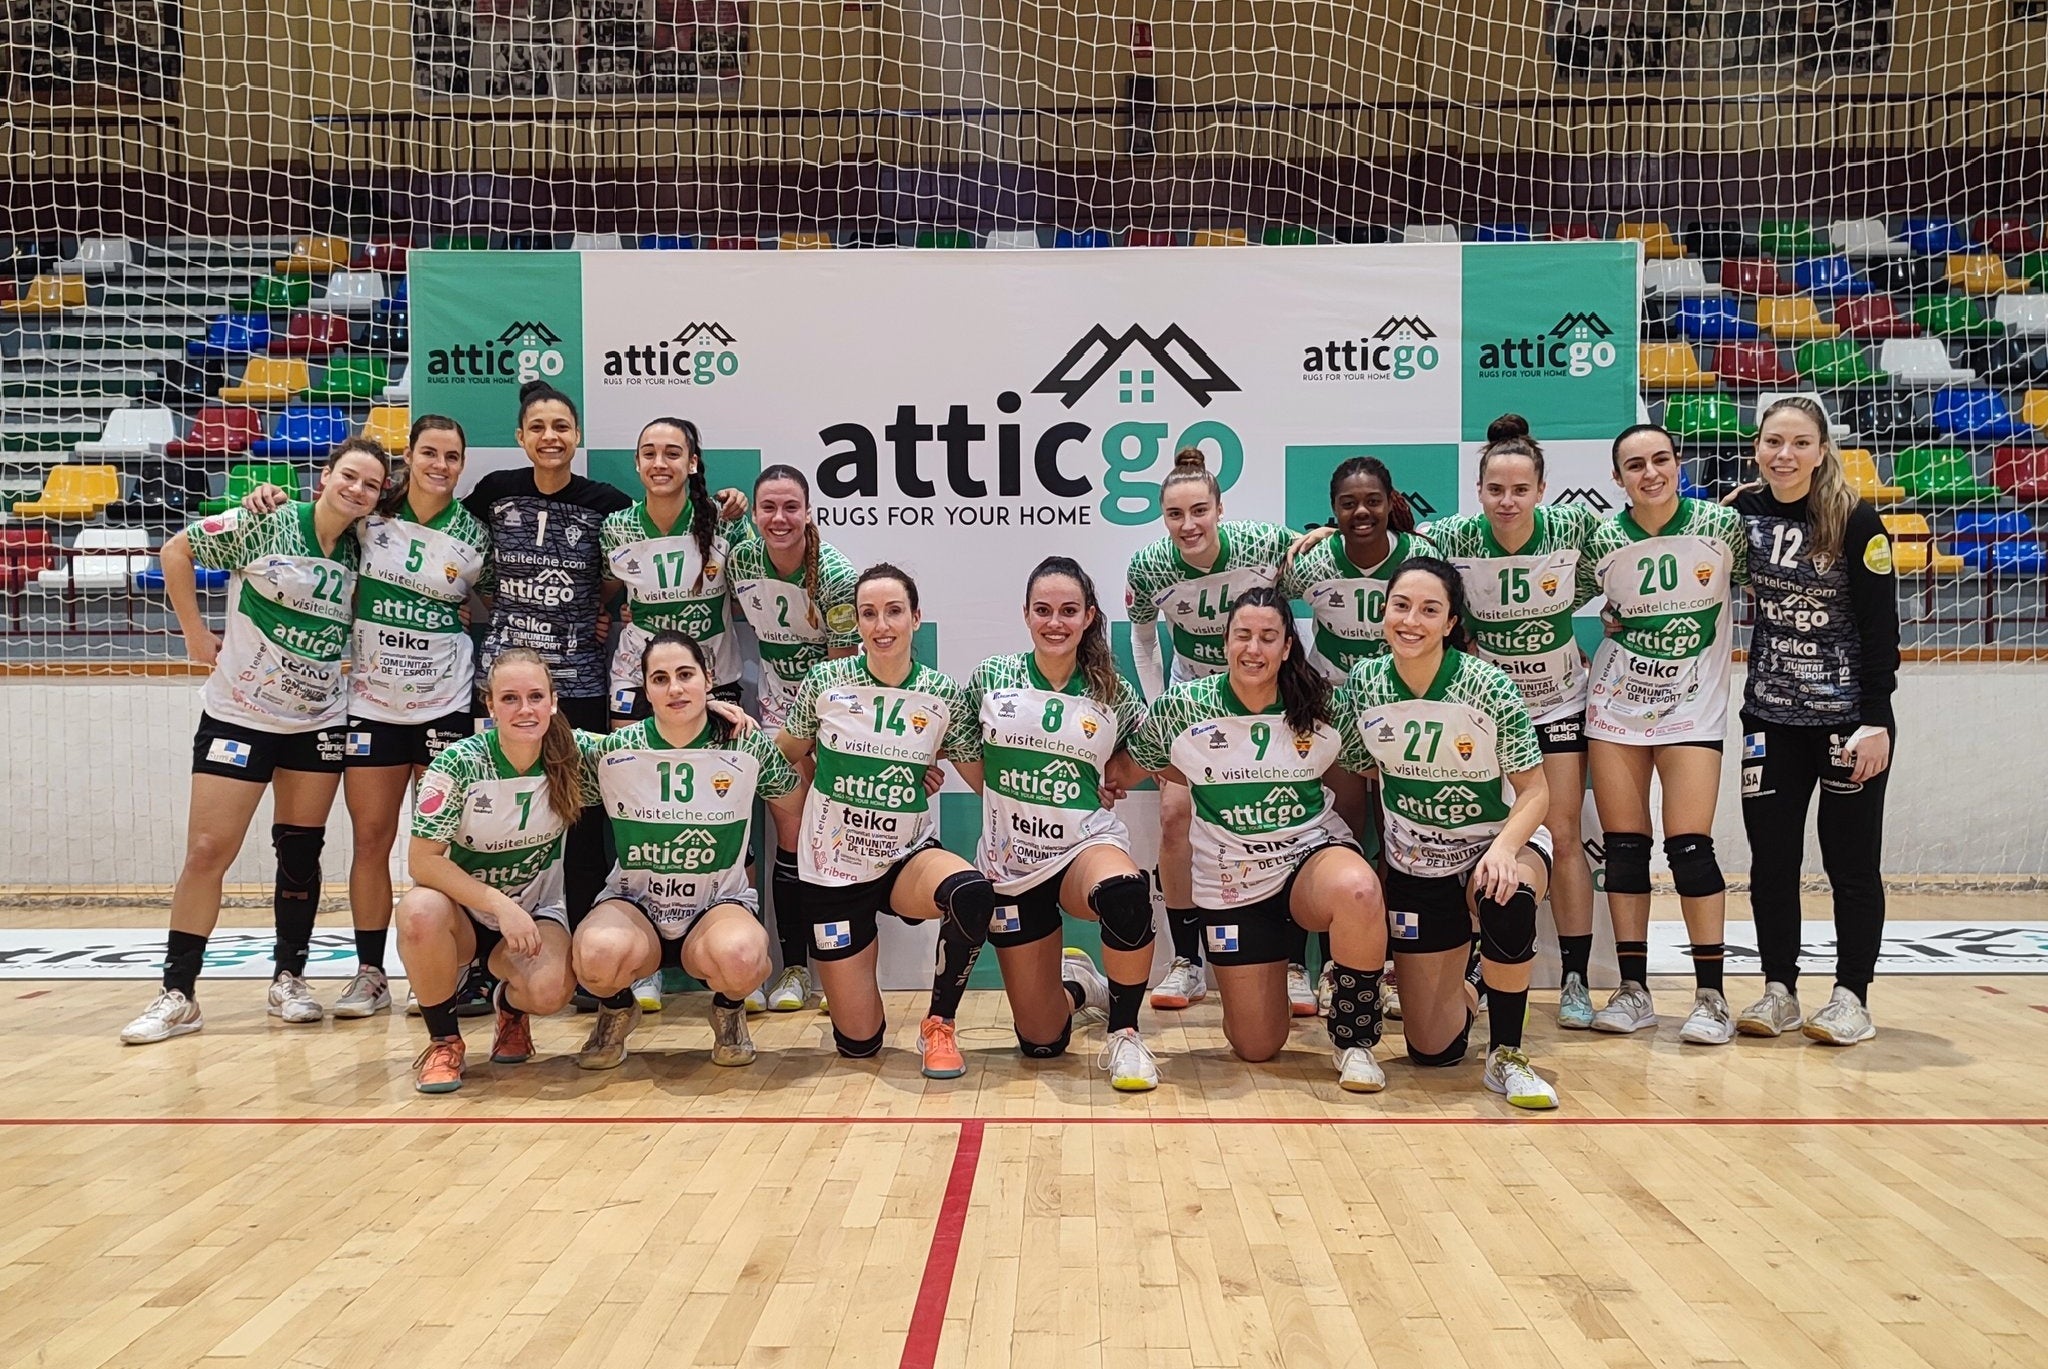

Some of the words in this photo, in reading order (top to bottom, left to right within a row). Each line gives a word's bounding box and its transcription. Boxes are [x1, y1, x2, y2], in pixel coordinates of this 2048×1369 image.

[427, 341, 564, 384] atticgo
[604, 341, 738, 385] atticgo
[1303, 338, 1438, 380] atticgo
[1480, 335, 1616, 376] atticgo
[1303, 373, 1324, 381] RUGS
[1327, 373, 1341, 381] FOR
[1344, 373, 1364, 381] YOUR
[1366, 373, 1390, 381] HOME
[1480, 370, 1501, 378] RUGS
[1504, 370, 1517, 378] FOR
[1520, 370, 1542, 378] YOUR
[1544, 370, 1567, 378] HOME
[816, 390, 1244, 526] atticgo
[536, 511, 547, 546] 1
[817, 507, 877, 526] RUGS
[888, 507, 935, 526] FOR
[945, 507, 1010, 526] YOUR
[1020, 506, 1091, 526] HOME
[405, 539, 425, 573] 5
[1770, 525, 1803, 569] 12
[502, 553, 586, 569] visitelche.com
[653, 551, 684, 588] 17
[312, 565, 342, 604] 22
[1498, 568, 1530, 605] 15
[1637, 554, 1678, 596] 20
[500, 578, 574, 605] atticgo
[373, 599, 454, 629] atticgo
[776, 596, 790, 627] 2
[1354, 589, 1385, 622] 10
[1476, 601, 1568, 619] visitelche.com
[1627, 597, 1714, 615] visitelche.com
[508, 614, 551, 633] teika
[379, 630, 429, 651] teika
[1477, 631, 1555, 651] atticgo
[1626, 630, 1700, 656] atticgo
[1771, 637, 1817, 656] teika
[382, 667, 394, 675] DE
[1629, 657, 1678, 678] teika
[1628, 693, 1639, 702] DE
[873, 696, 906, 736] 14
[1042, 698, 1064, 732] 8
[1594, 720, 1625, 735] ribera
[1004, 733, 1098, 762] visitelche.com
[1250, 722, 1270, 760] 9
[1404, 720, 1444, 763] 27
[1549, 731, 1576, 742] tesla
[845, 740, 930, 762] visitelche.com
[656, 762, 694, 803] 13
[1222, 766, 1314, 780] visitelche.com
[1394, 764, 1490, 780] visitelche.com
[834, 775, 915, 808] atticgo
[1000, 769, 1080, 803] atticgo
[515, 791, 535, 830] 7
[634, 807, 735, 821] visitelche.com
[816, 797, 832, 834] teleelx
[843, 808, 897, 832] teika
[1220, 801, 1306, 827] atticgo
[1397, 794, 1482, 824] atticgo
[846, 829, 870, 837] omunitat
[1011, 813, 1063, 839] teika
[628, 841, 715, 869] atticgo
[1259, 859, 1273, 870] DE
[1426, 858, 1440, 867] DE
[824, 866, 858, 881] ribera
[648, 877, 695, 897] teika
